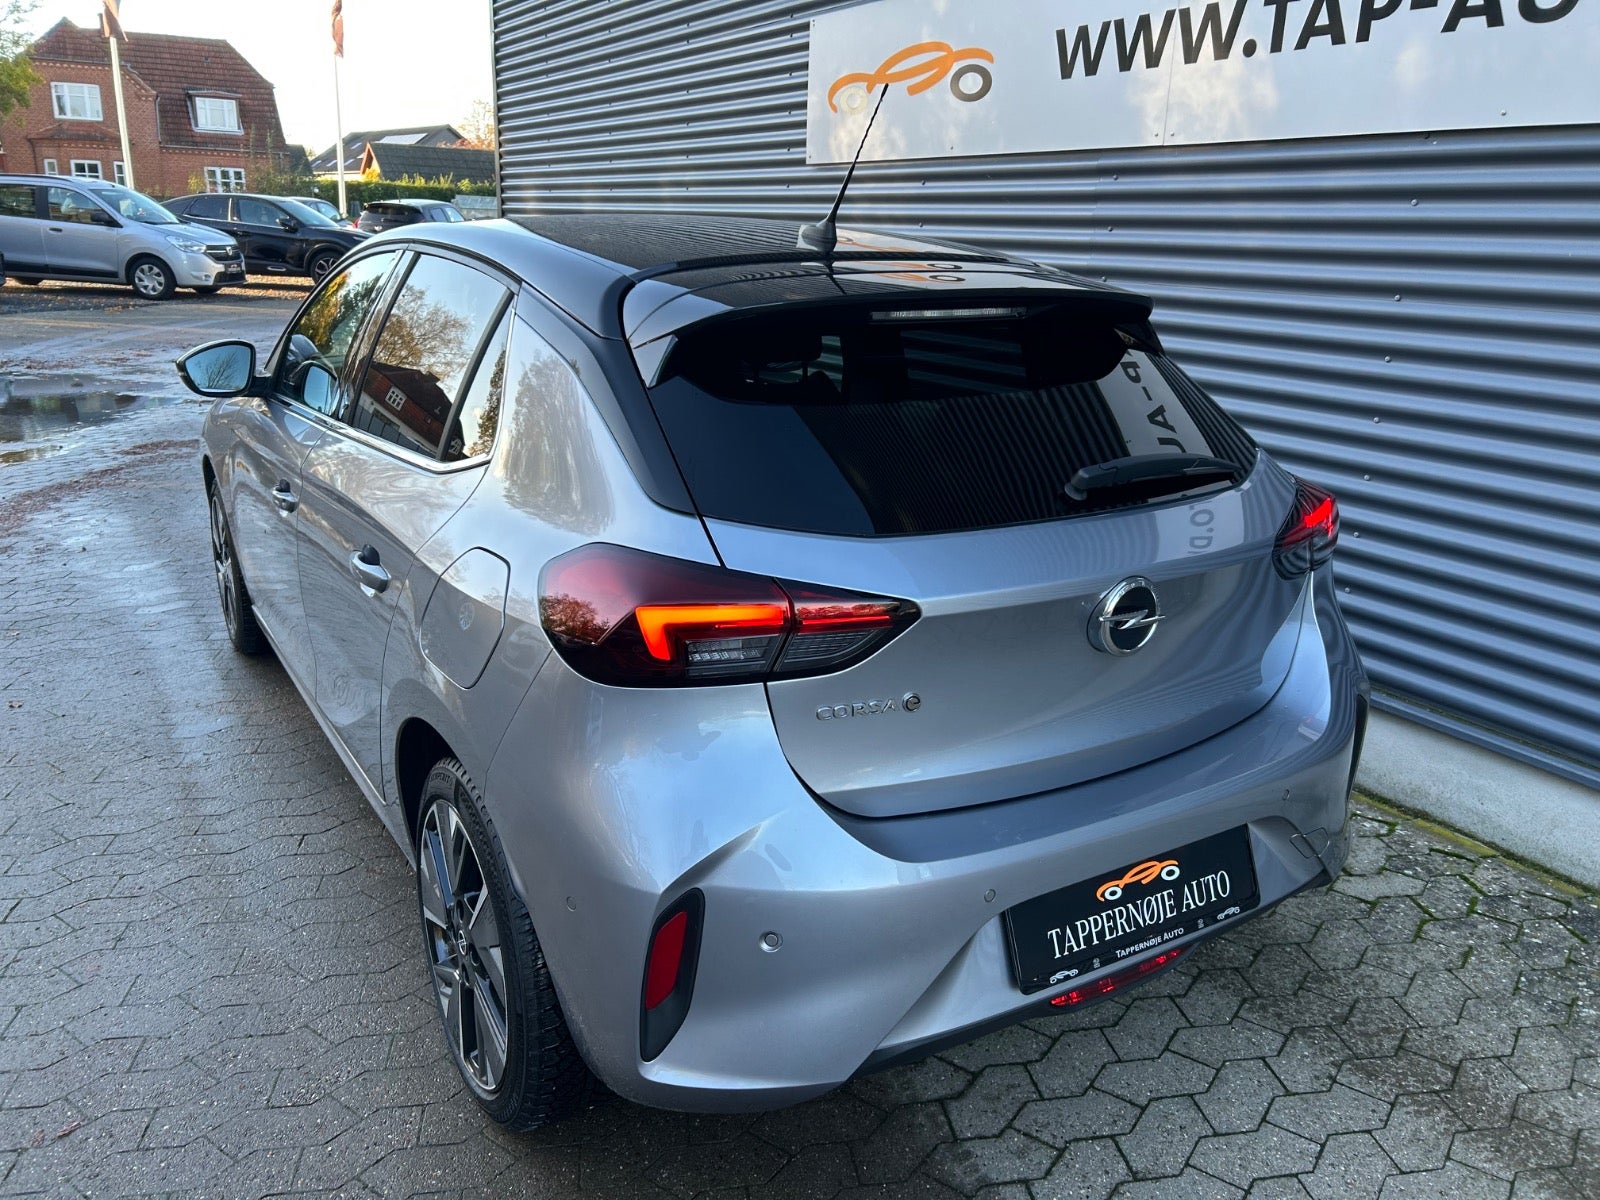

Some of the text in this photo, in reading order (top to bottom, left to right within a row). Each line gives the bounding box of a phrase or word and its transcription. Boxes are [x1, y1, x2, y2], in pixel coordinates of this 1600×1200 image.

[816, 699, 896, 720] CORSA
[1048, 870, 1230, 959] TAPPERNØJE AUTO
[1163, 927, 1184, 941] AUTO
